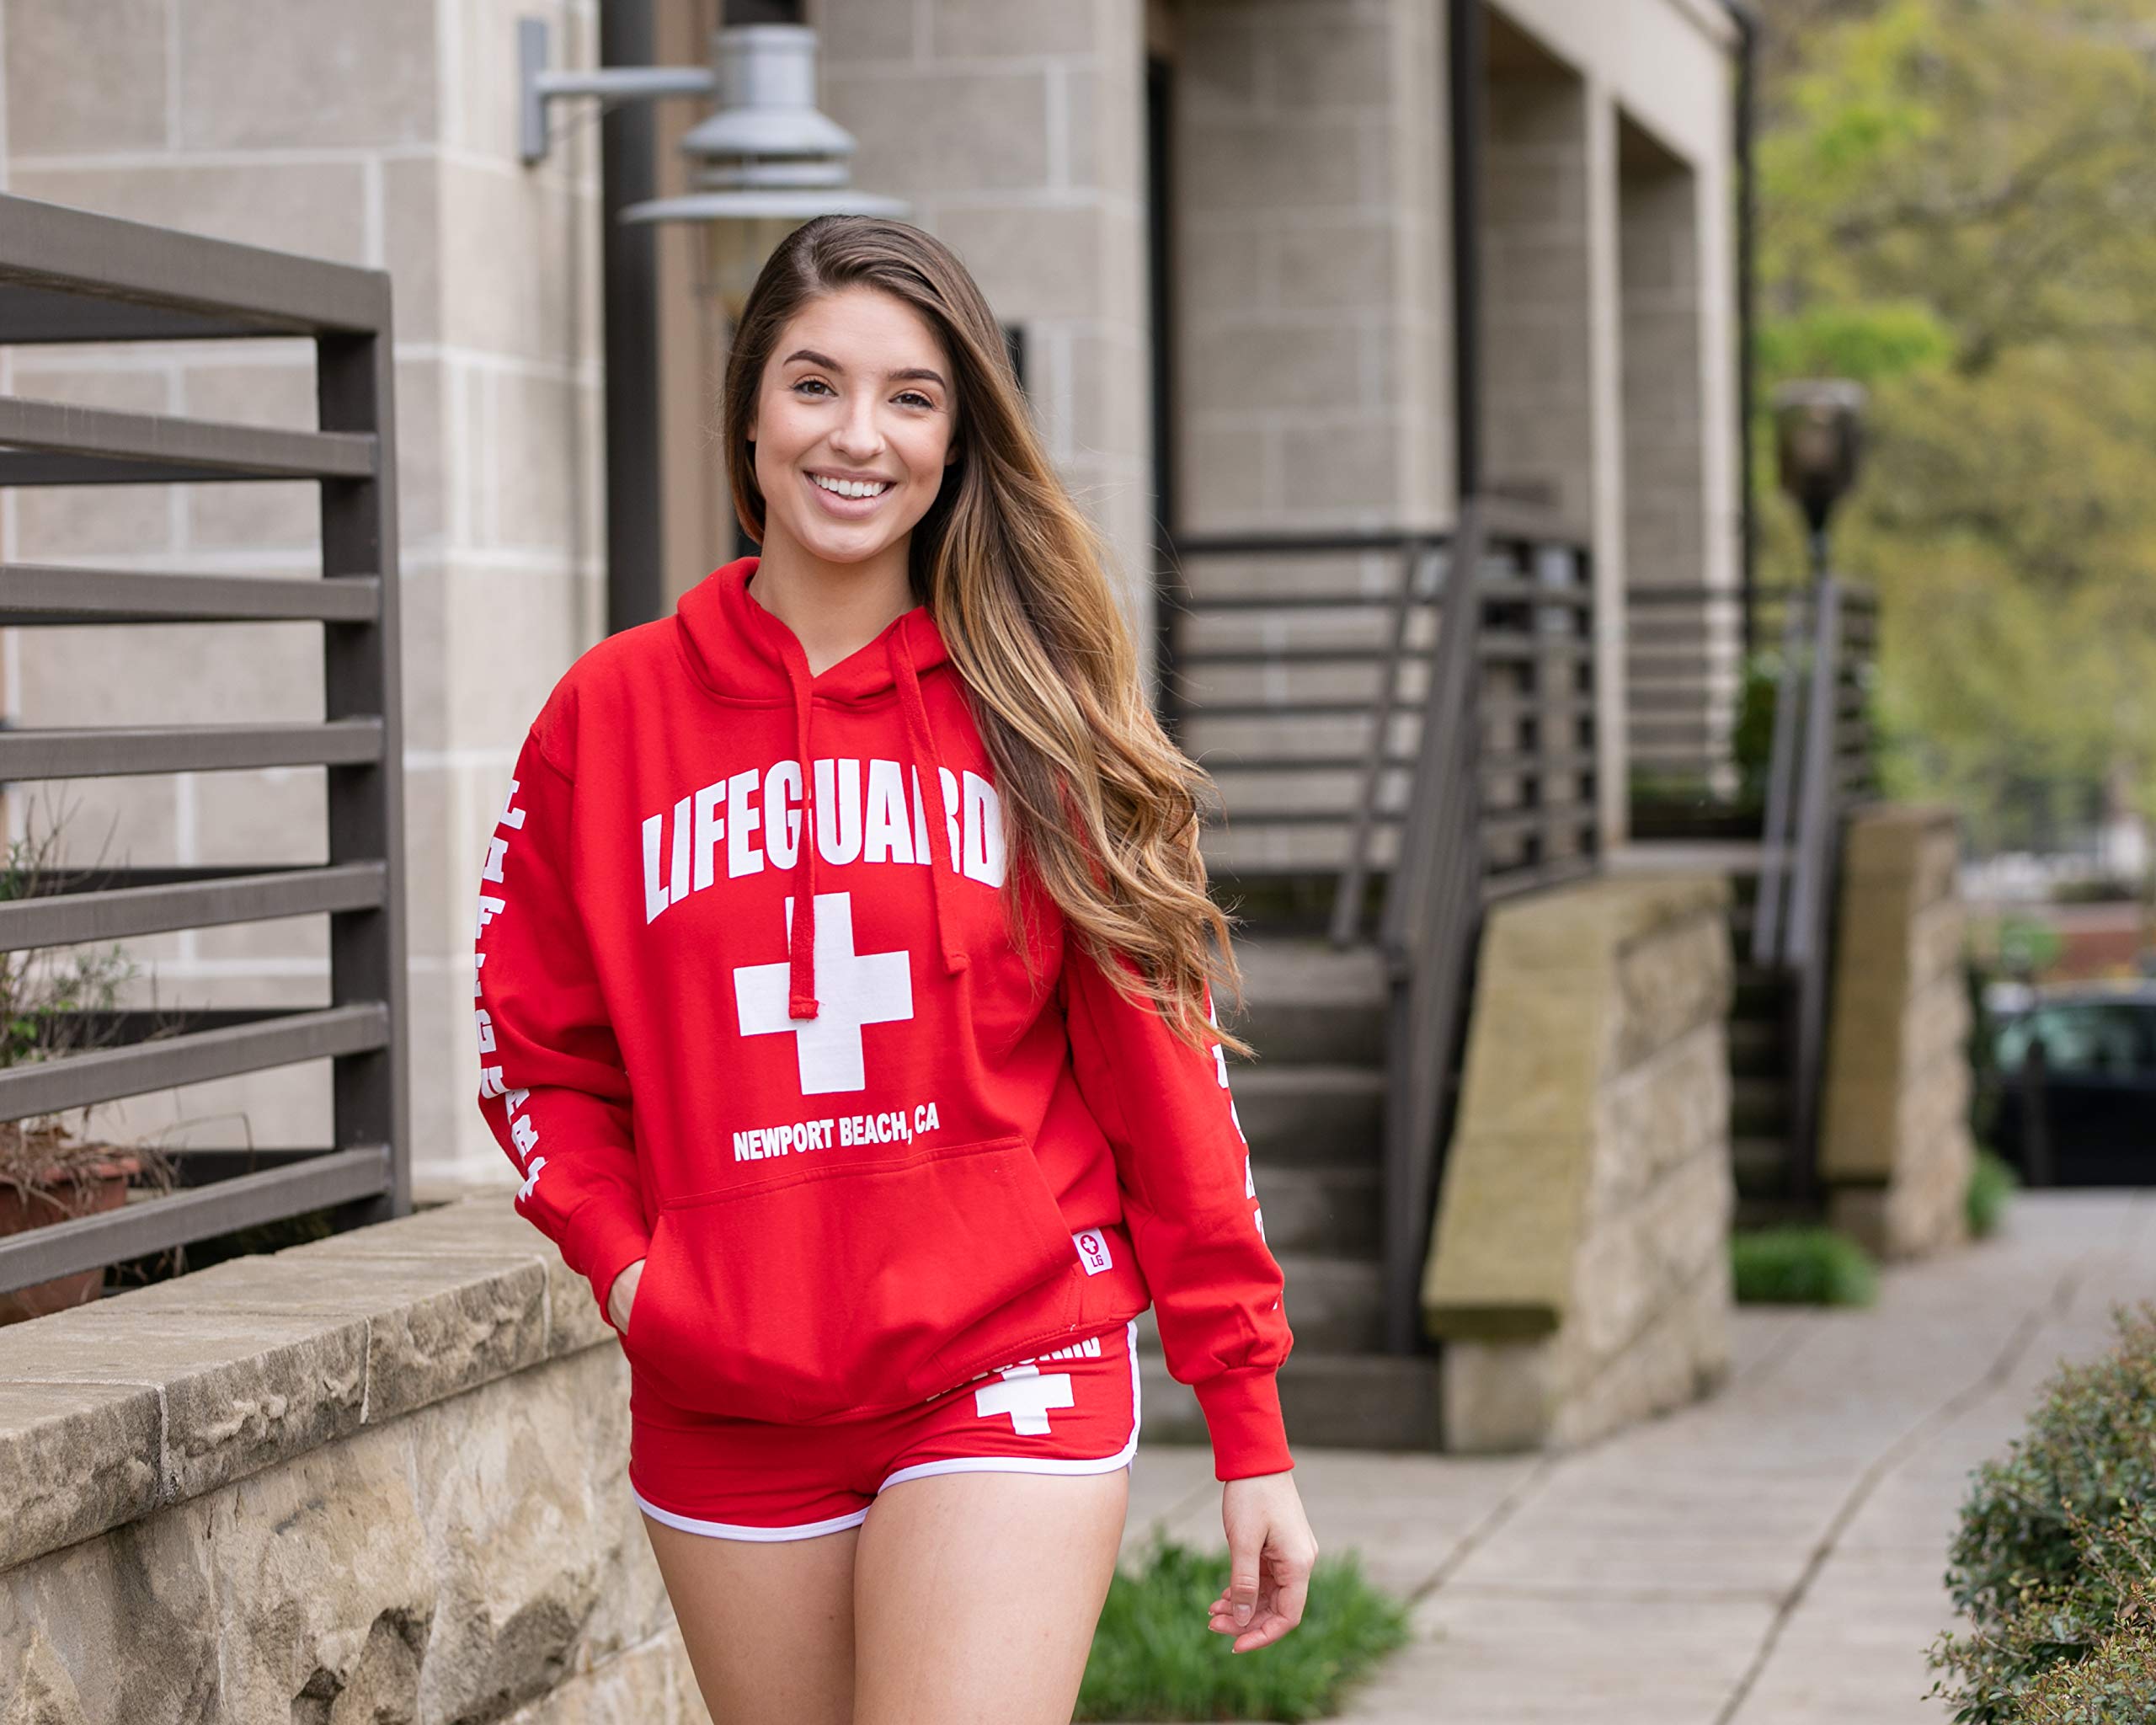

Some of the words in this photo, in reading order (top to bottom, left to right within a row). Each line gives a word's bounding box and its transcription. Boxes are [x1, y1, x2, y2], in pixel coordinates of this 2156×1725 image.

[643, 758, 1006, 925] LIFEGUARD
[733, 1119, 834, 1162] NEWPORT
[839, 1110, 912, 1145] BEACH,
[914, 1103, 940, 1134] CA
[1090, 1254, 1104, 1267] LG
